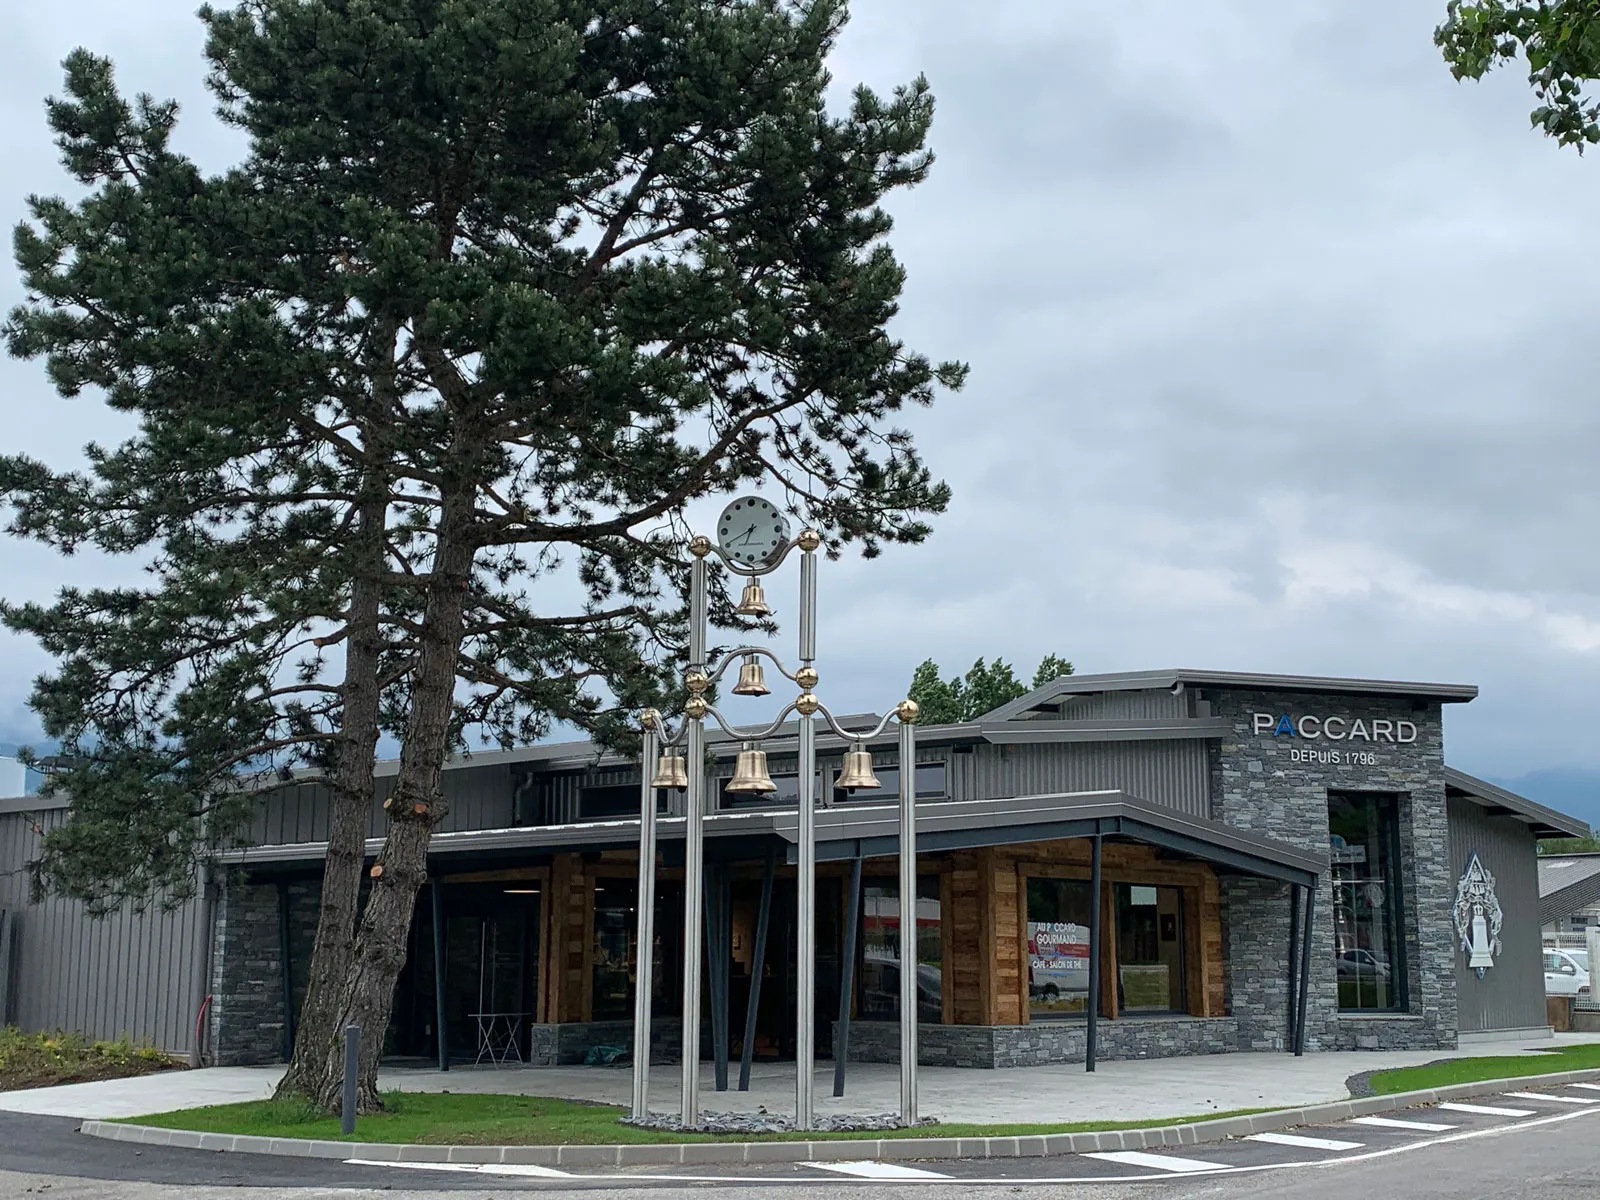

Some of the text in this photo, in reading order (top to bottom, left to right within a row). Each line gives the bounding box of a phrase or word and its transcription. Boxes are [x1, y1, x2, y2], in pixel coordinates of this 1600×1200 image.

[1253, 713, 1417, 743] PACCARD
[1291, 749, 1375, 765] DEPUIS 1796
[1037, 922, 1046, 932] AU
[1036, 934, 1077, 944] GOURMAND
[1049, 960, 1066, 968] SALON
[1066, 960, 1073, 968] DE
